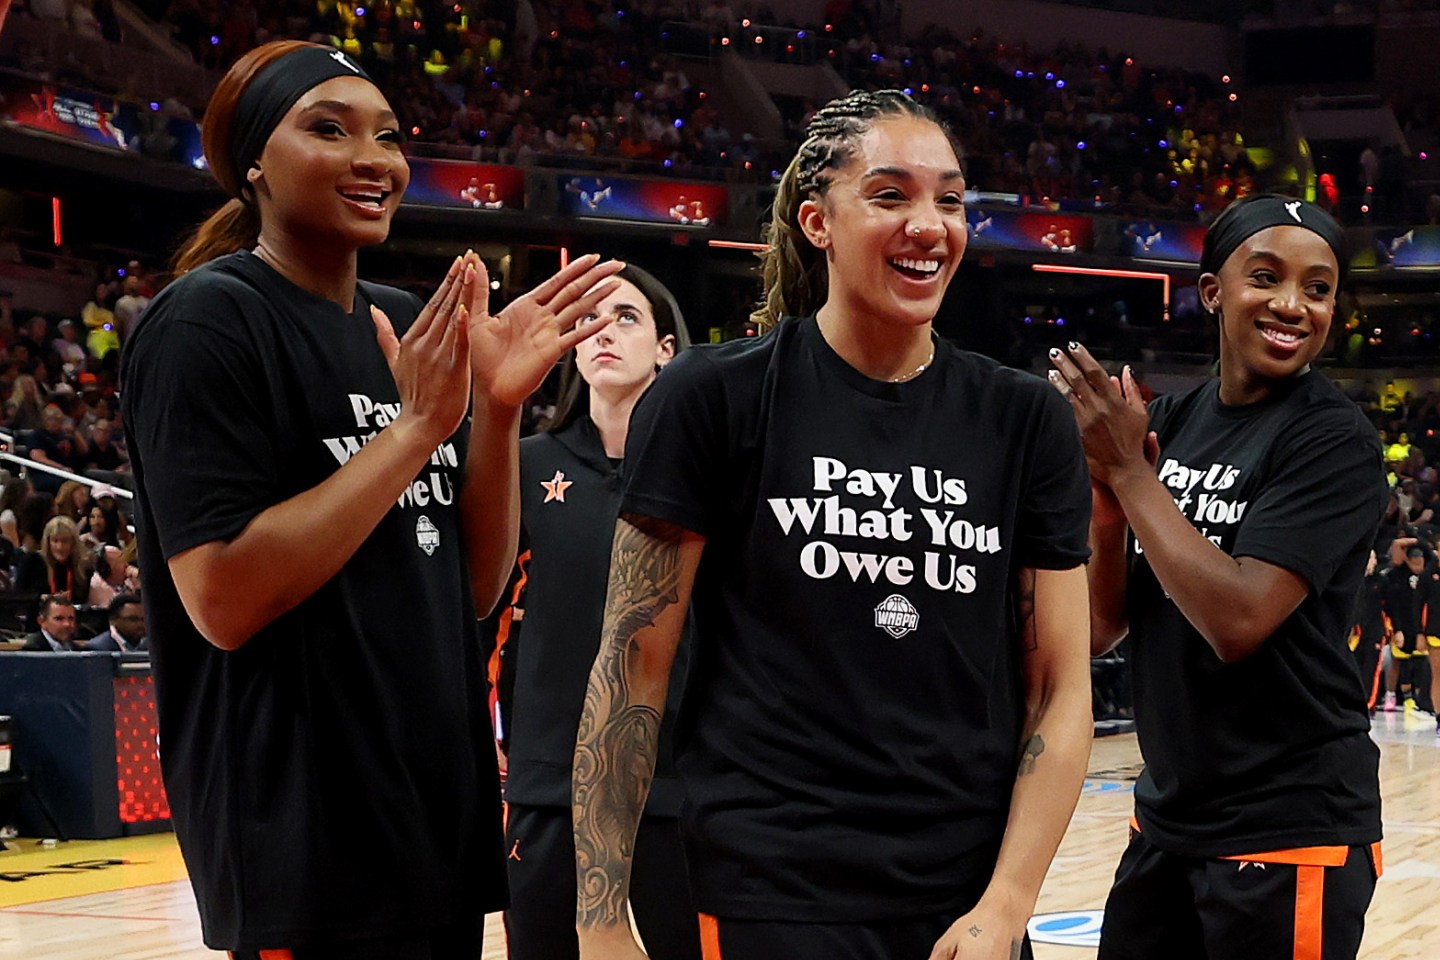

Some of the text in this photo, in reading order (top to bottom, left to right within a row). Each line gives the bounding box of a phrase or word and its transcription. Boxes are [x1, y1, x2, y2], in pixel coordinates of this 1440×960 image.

[397, 480, 430, 509] we
[813, 456, 968, 509] Pay Us
[1158, 458, 1241, 498] Pay Us
[767, 494, 1002, 554] What You
[1193, 493, 1248, 525] You
[800, 540, 977, 594] Owe Us
[878, 610, 917, 628] WNBPA
